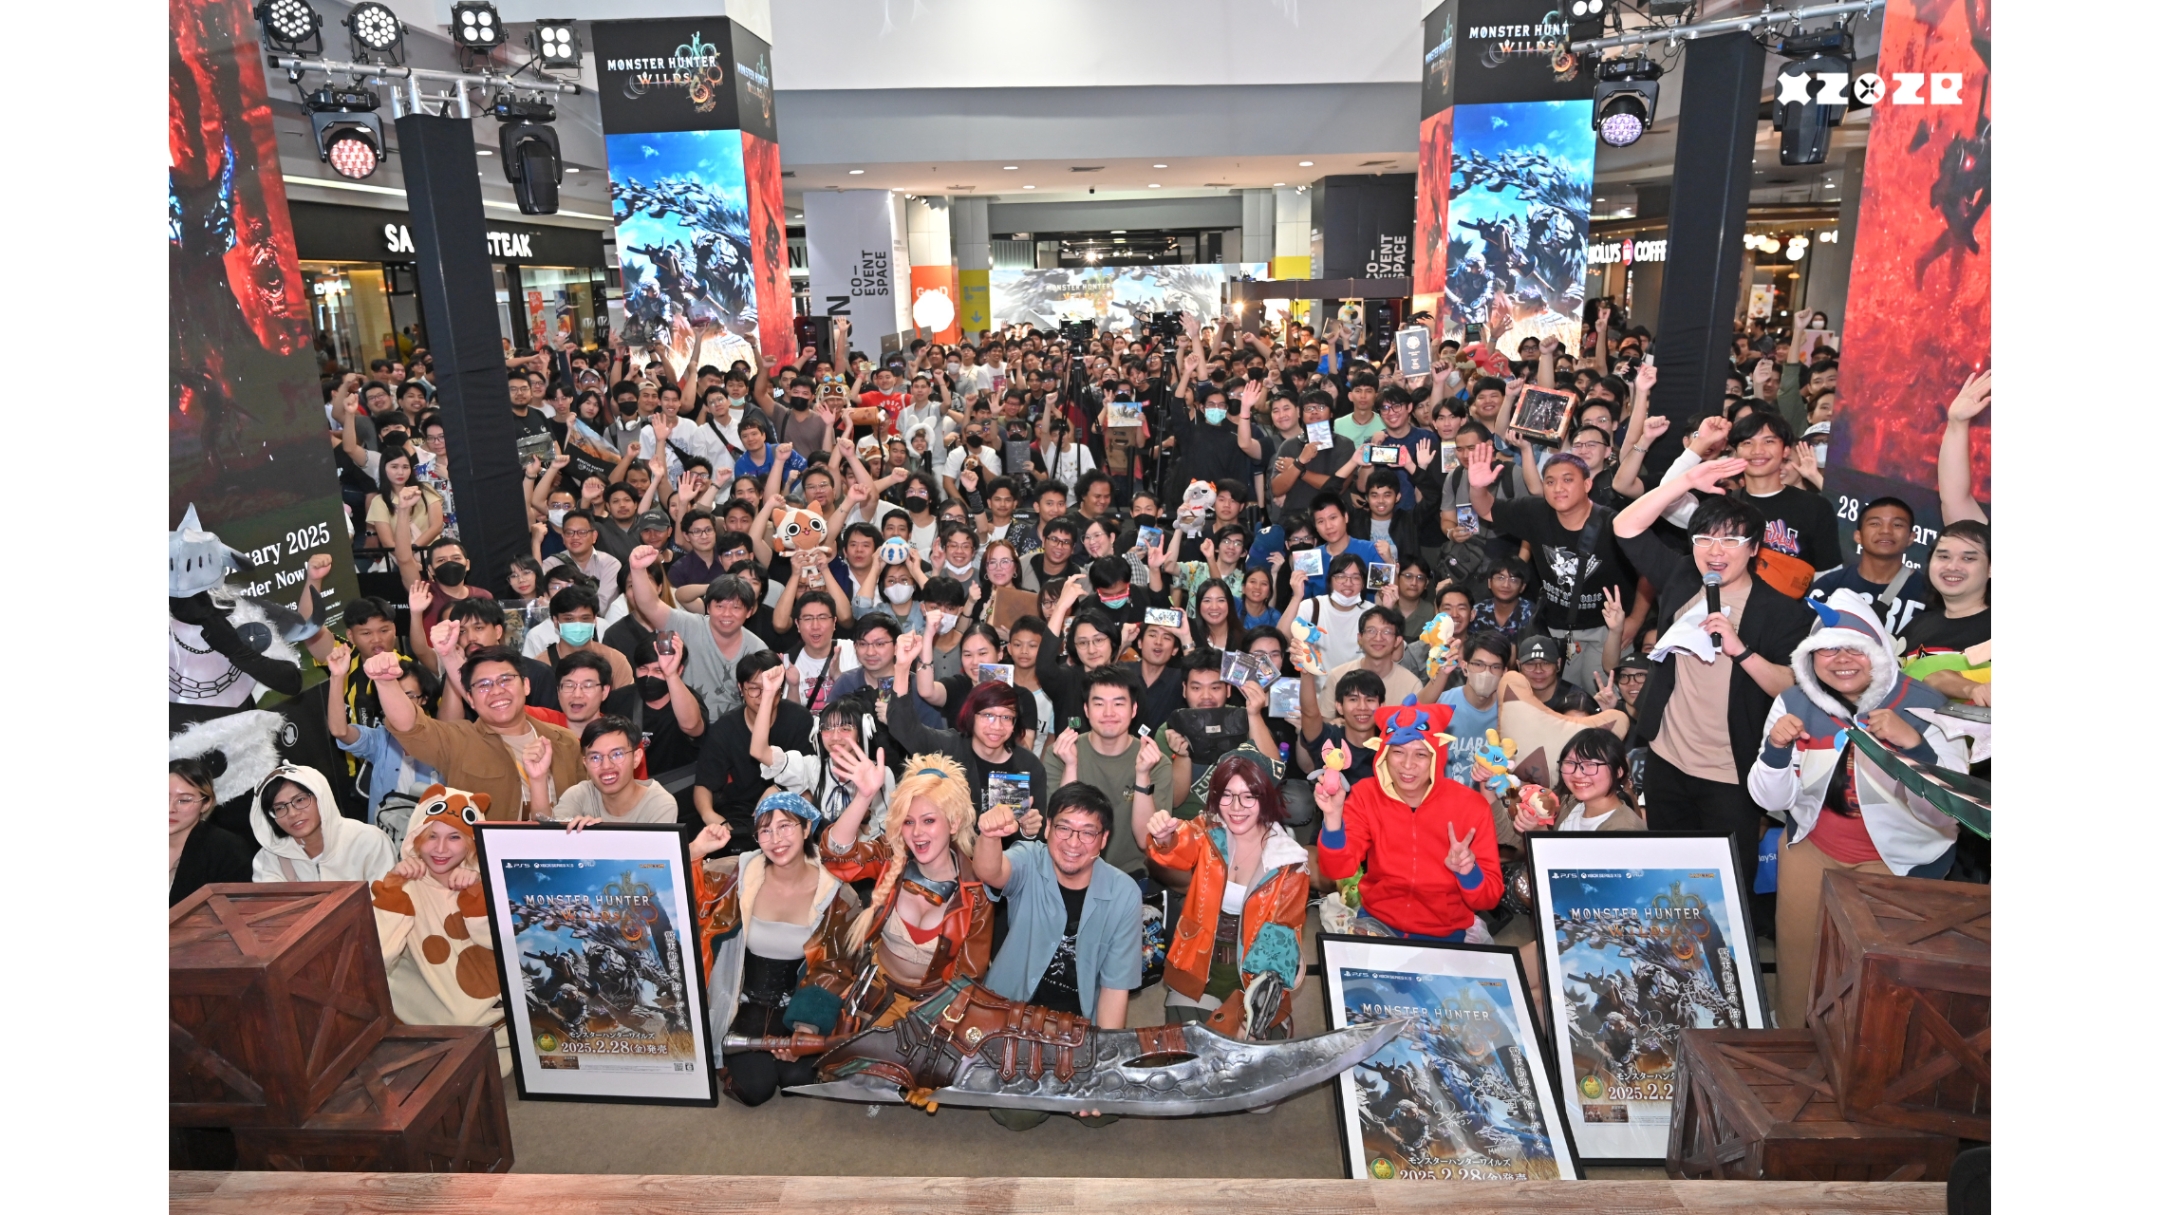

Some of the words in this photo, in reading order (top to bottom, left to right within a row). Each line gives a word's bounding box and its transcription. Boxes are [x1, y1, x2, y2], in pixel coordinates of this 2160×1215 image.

[1469, 24, 1530, 38] MONSTER
[1534, 24, 1569, 36] HUNT
[1498, 40, 1556, 56] WILDS
[607, 58, 665, 71] MONSTER
[668, 56, 716, 68] HUNTER
[637, 72, 690, 87] WILDS
[862, 250, 876, 296] EVENT
[875, 251, 888, 296] SPACE
[1046, 284, 1080, 292] MONSTER
[1837, 495, 1859, 522] 28
[286, 522, 330, 555] 2025
[525, 894, 589, 906] MONSTER
[596, 894, 650, 906] HUNTER
[561, 910, 621, 922] WILDS
[1572, 908, 1638, 920] MONSTER
[1644, 908, 1700, 920] HUNTER
[1608, 924, 1671, 936] WILDS
[1362, 1003, 1428, 1017] MONSTER
[1434, 1008, 1490, 1021] HUNTER
[569, 1032, 655, 1040] モンスターハンターワイルズ
[561, 1040, 668, 1055] 2025.2.28(金)発売
[1408, 1157, 1512, 1167] モンスターハンターワイルズ
